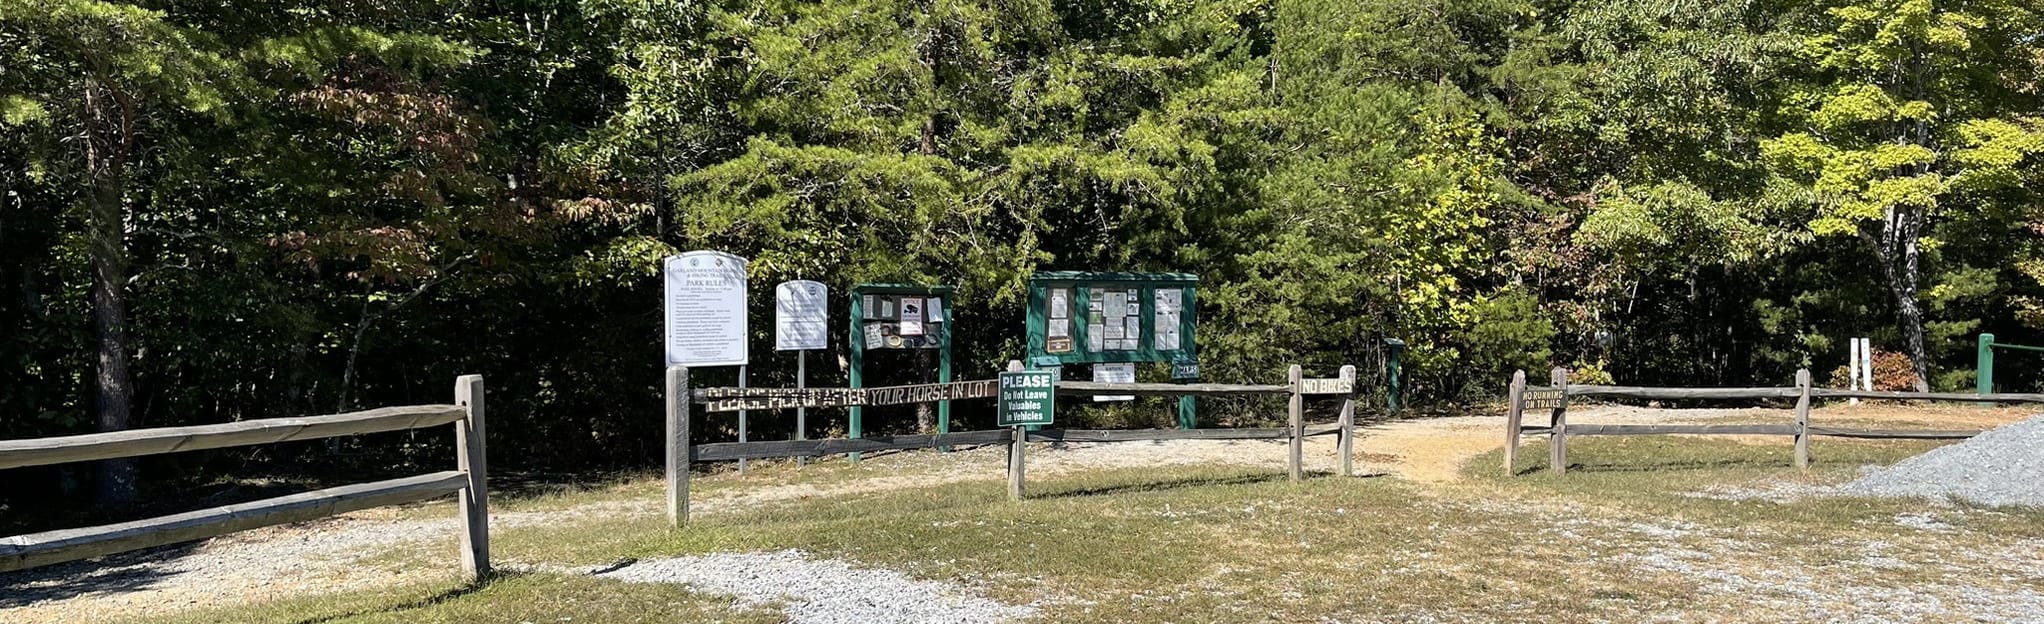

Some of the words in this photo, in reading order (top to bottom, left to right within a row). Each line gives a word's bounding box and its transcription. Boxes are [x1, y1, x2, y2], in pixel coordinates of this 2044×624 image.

[1002, 375, 1050, 389] PLEASE
[1302, 379, 1317, 393] NO
[1320, 379, 1352, 393] BIKES
[823, 387, 867, 406] AFTER
[871, 387, 904, 406] YOUR
[907, 383, 949, 403] HORSE
[951, 382, 964, 399] IN
[968, 381, 990, 398] LOT
[1004, 391, 1012, 400] Do
[1012, 391, 1024, 400] Not
[1024, 390, 1048, 399] Leave
[1523, 391, 1533, 400] NO
[1533, 391, 1563, 400] RUNNING
[1008, 400, 1041, 410] Valuables
[1525, 400, 1535, 409] ON
[1537, 399, 1561, 408] TRAILS
[1006, 412, 1012, 421] in
[1013, 411, 1043, 421] Vehicles
